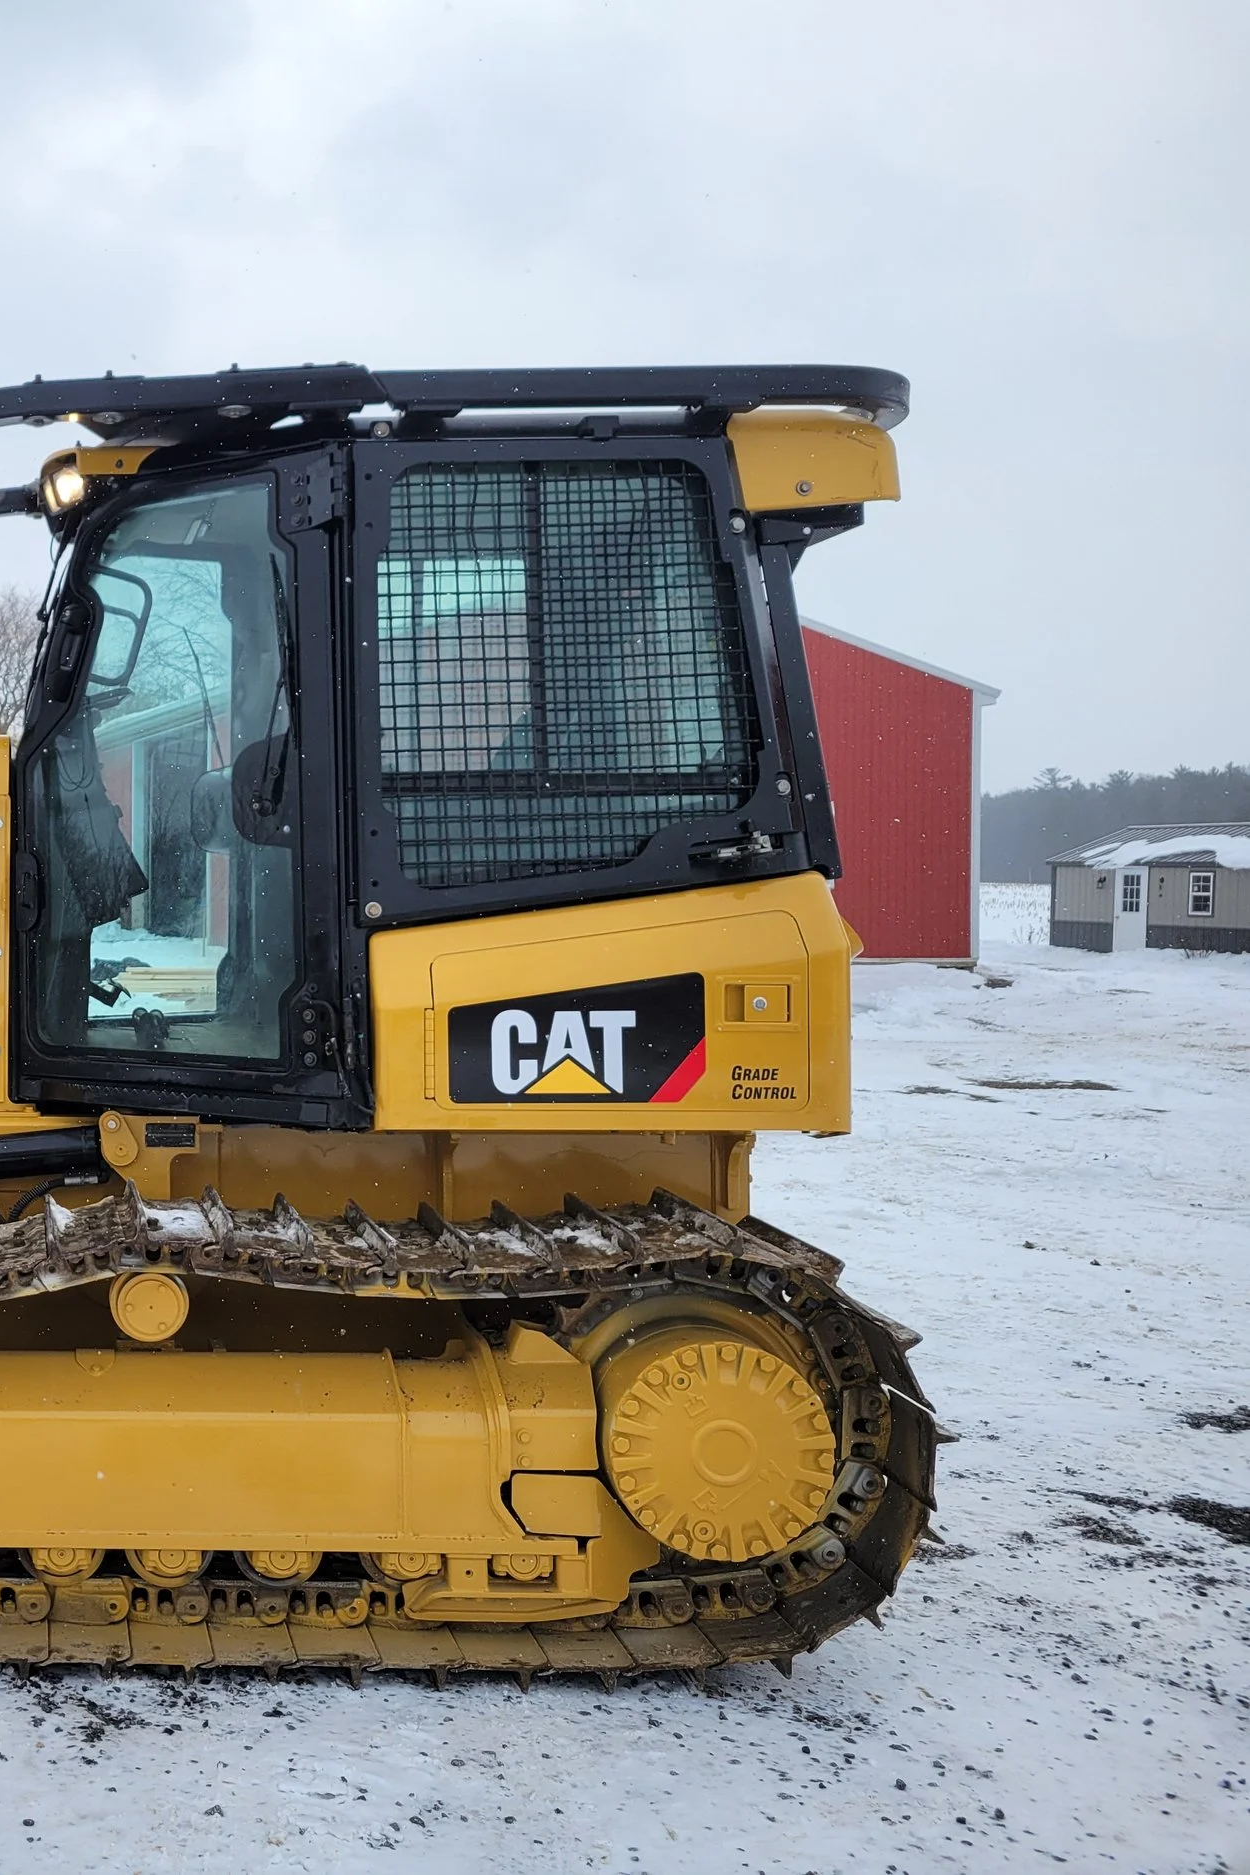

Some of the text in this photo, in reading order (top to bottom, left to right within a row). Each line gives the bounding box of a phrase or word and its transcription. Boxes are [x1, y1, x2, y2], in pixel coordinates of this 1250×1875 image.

[490, 1008, 636, 1095] CAT
[731, 1065, 780, 1081] GRADE
[731, 1083, 797, 1100] CONTROL
